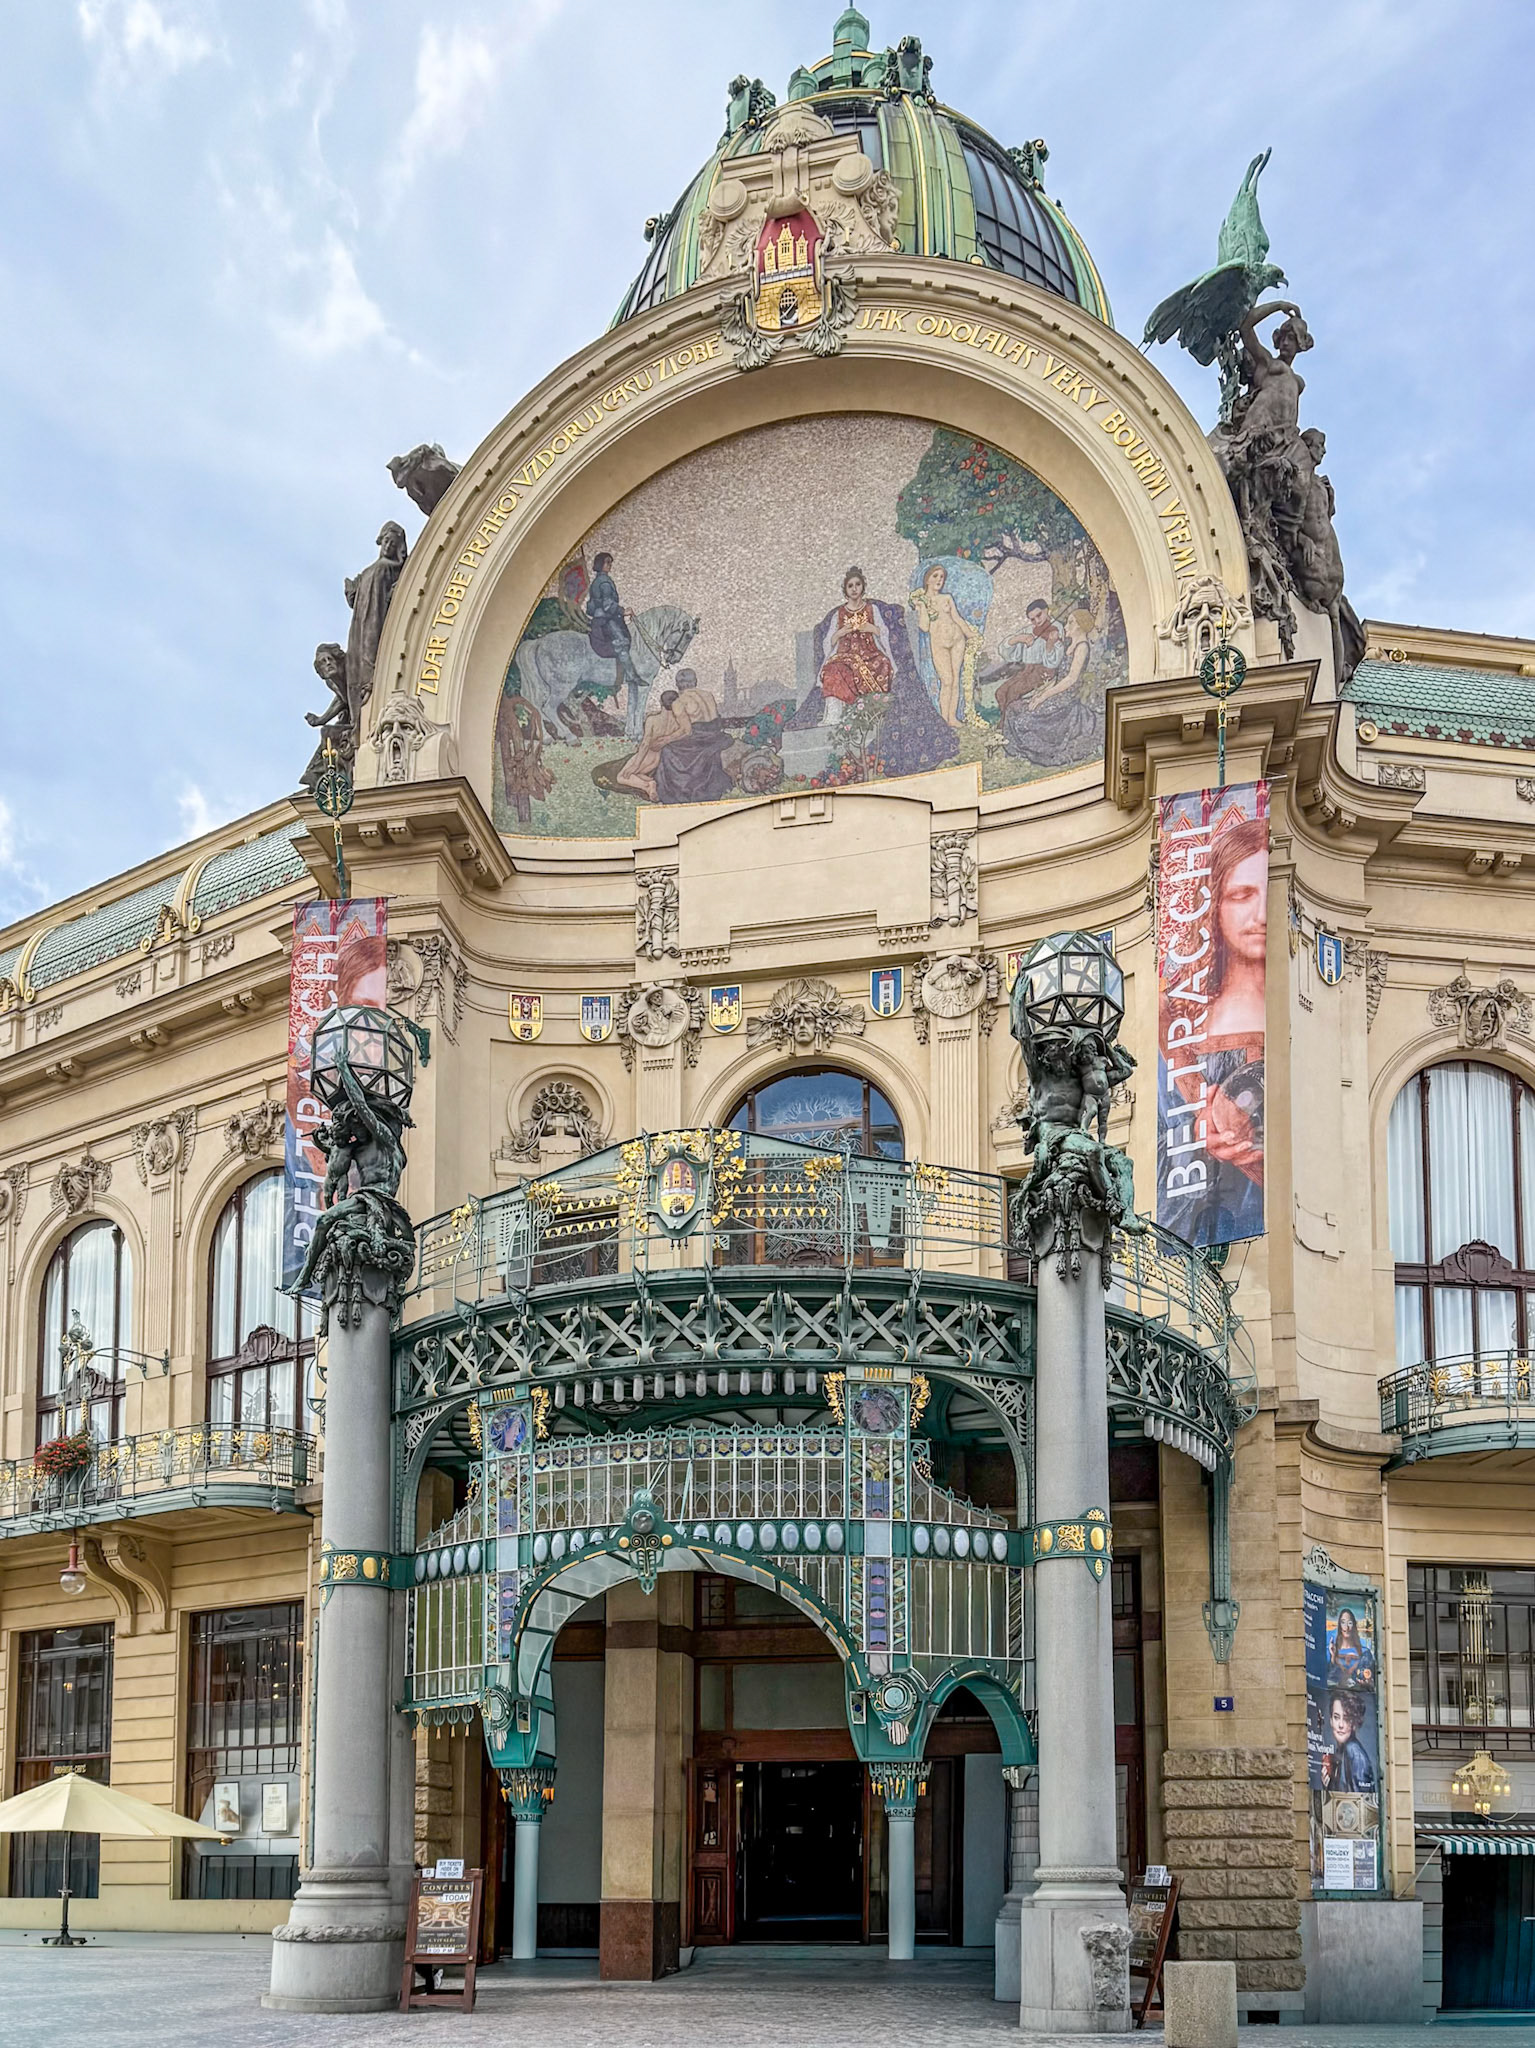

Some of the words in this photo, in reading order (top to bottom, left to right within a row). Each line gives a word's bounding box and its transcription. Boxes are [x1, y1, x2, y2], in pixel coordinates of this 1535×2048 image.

[855, 308, 907, 333] JAK
[914, 314, 1040, 370] ODOLALAS
[415, 634, 449, 696] ZDAR
[458, 486, 524, 569] PRAHO!
[1166, 825, 1213, 1200] BELTRACCHI
[1221, 1699, 1228, 1709] 5
[1148, 1903, 1165, 1911] TODAY
